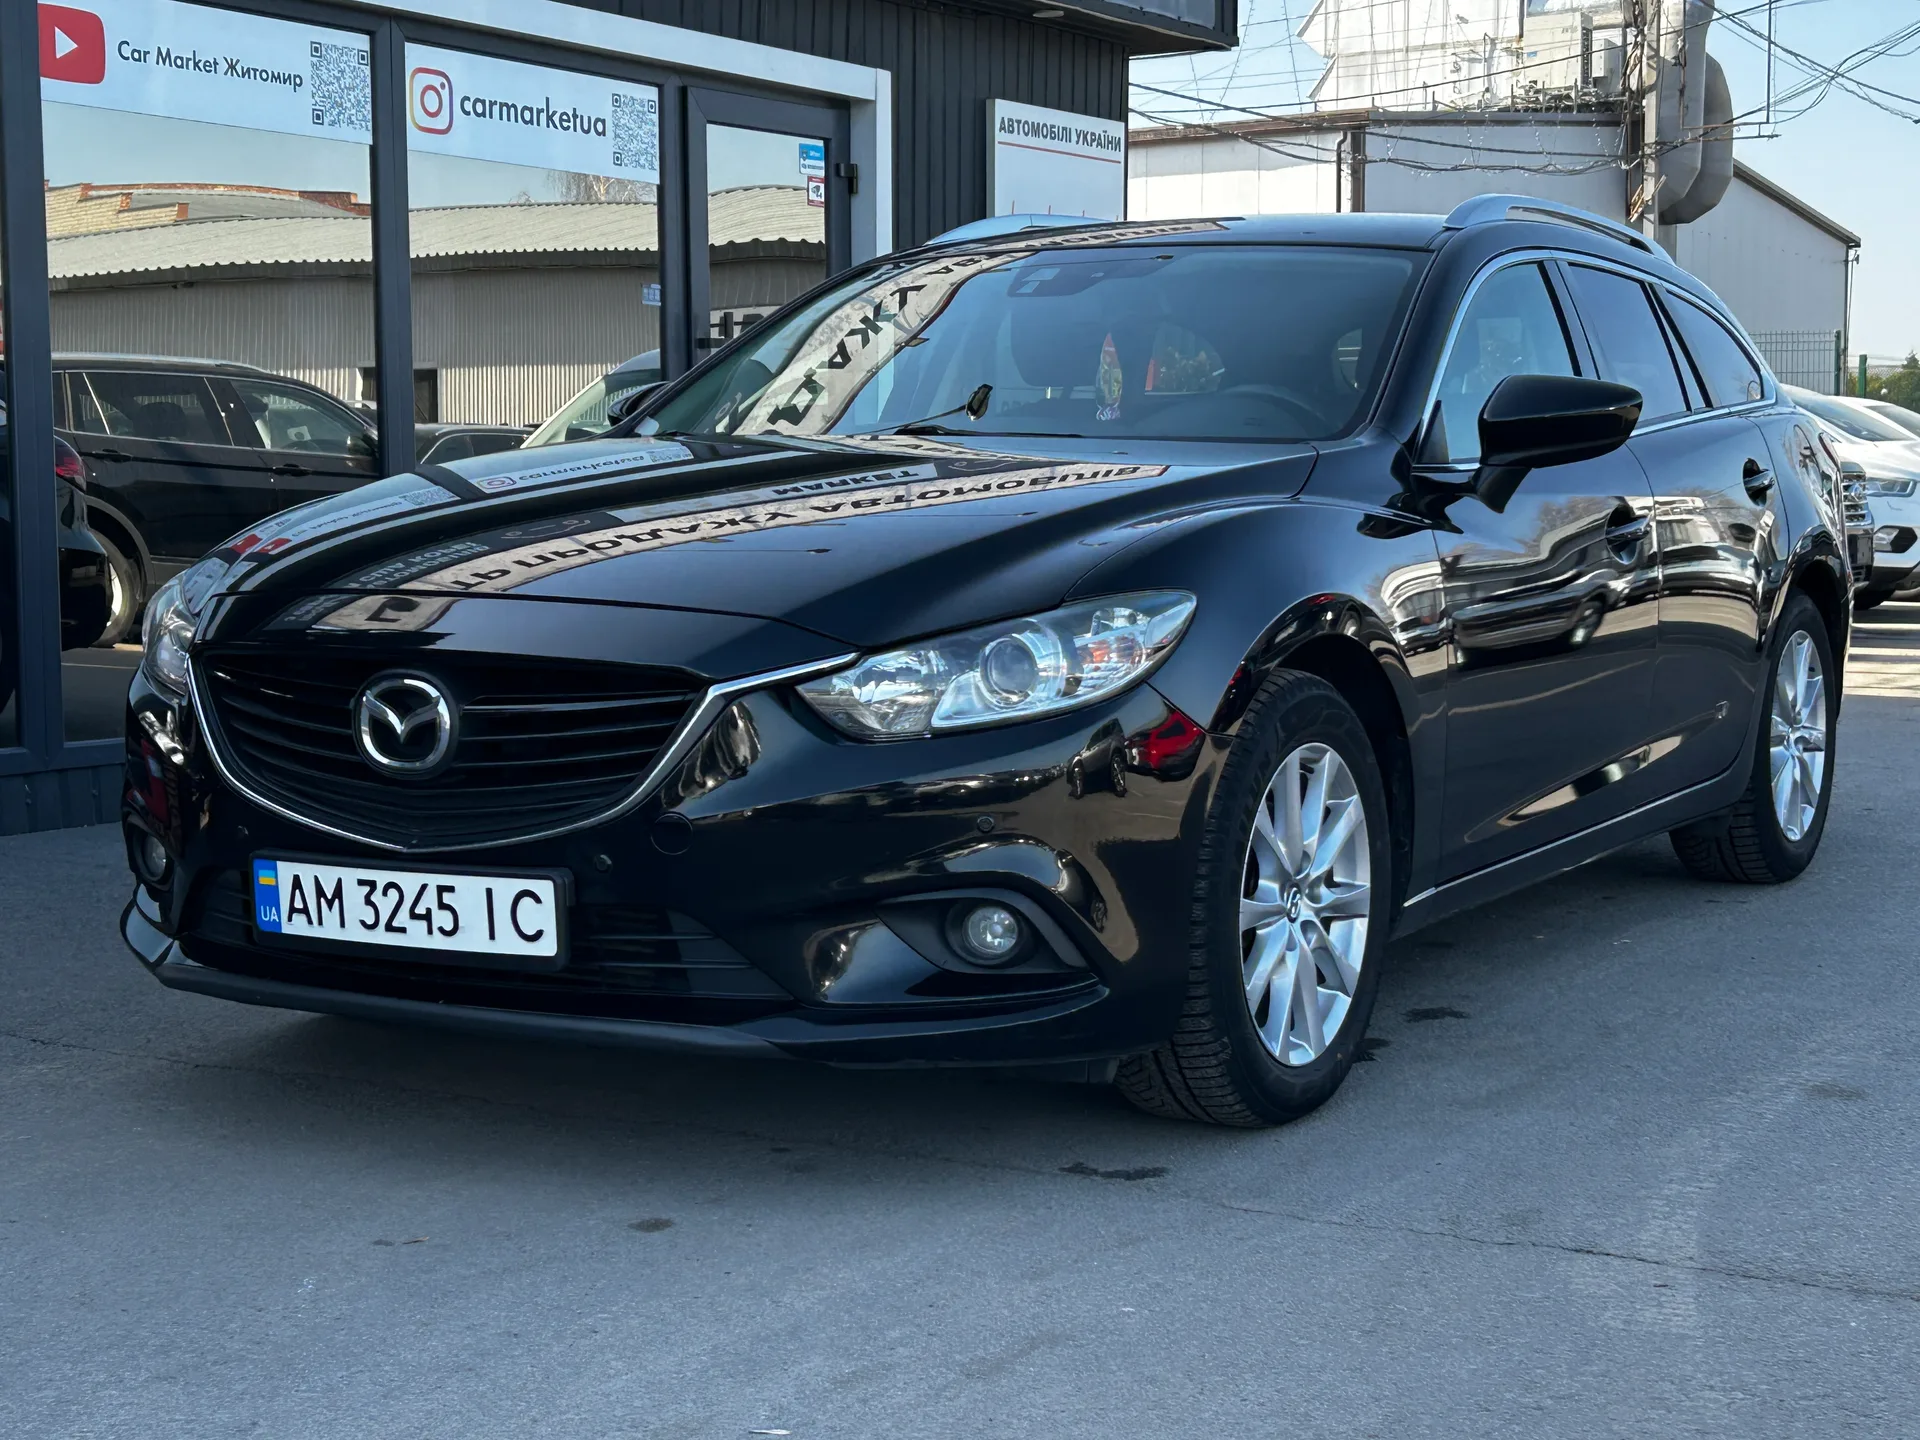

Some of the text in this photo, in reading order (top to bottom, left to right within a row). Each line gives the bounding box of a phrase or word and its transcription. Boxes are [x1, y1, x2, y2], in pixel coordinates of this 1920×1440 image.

[118, 40, 304, 92] Car Market Житомир
[460, 95, 607, 137] carmarketua
[998, 116, 1122, 153] АВТОМОБІЛІ УКРАЇНИ
[260, 905, 279, 922] UA
[287, 873, 545, 942] AM 3245 IC
